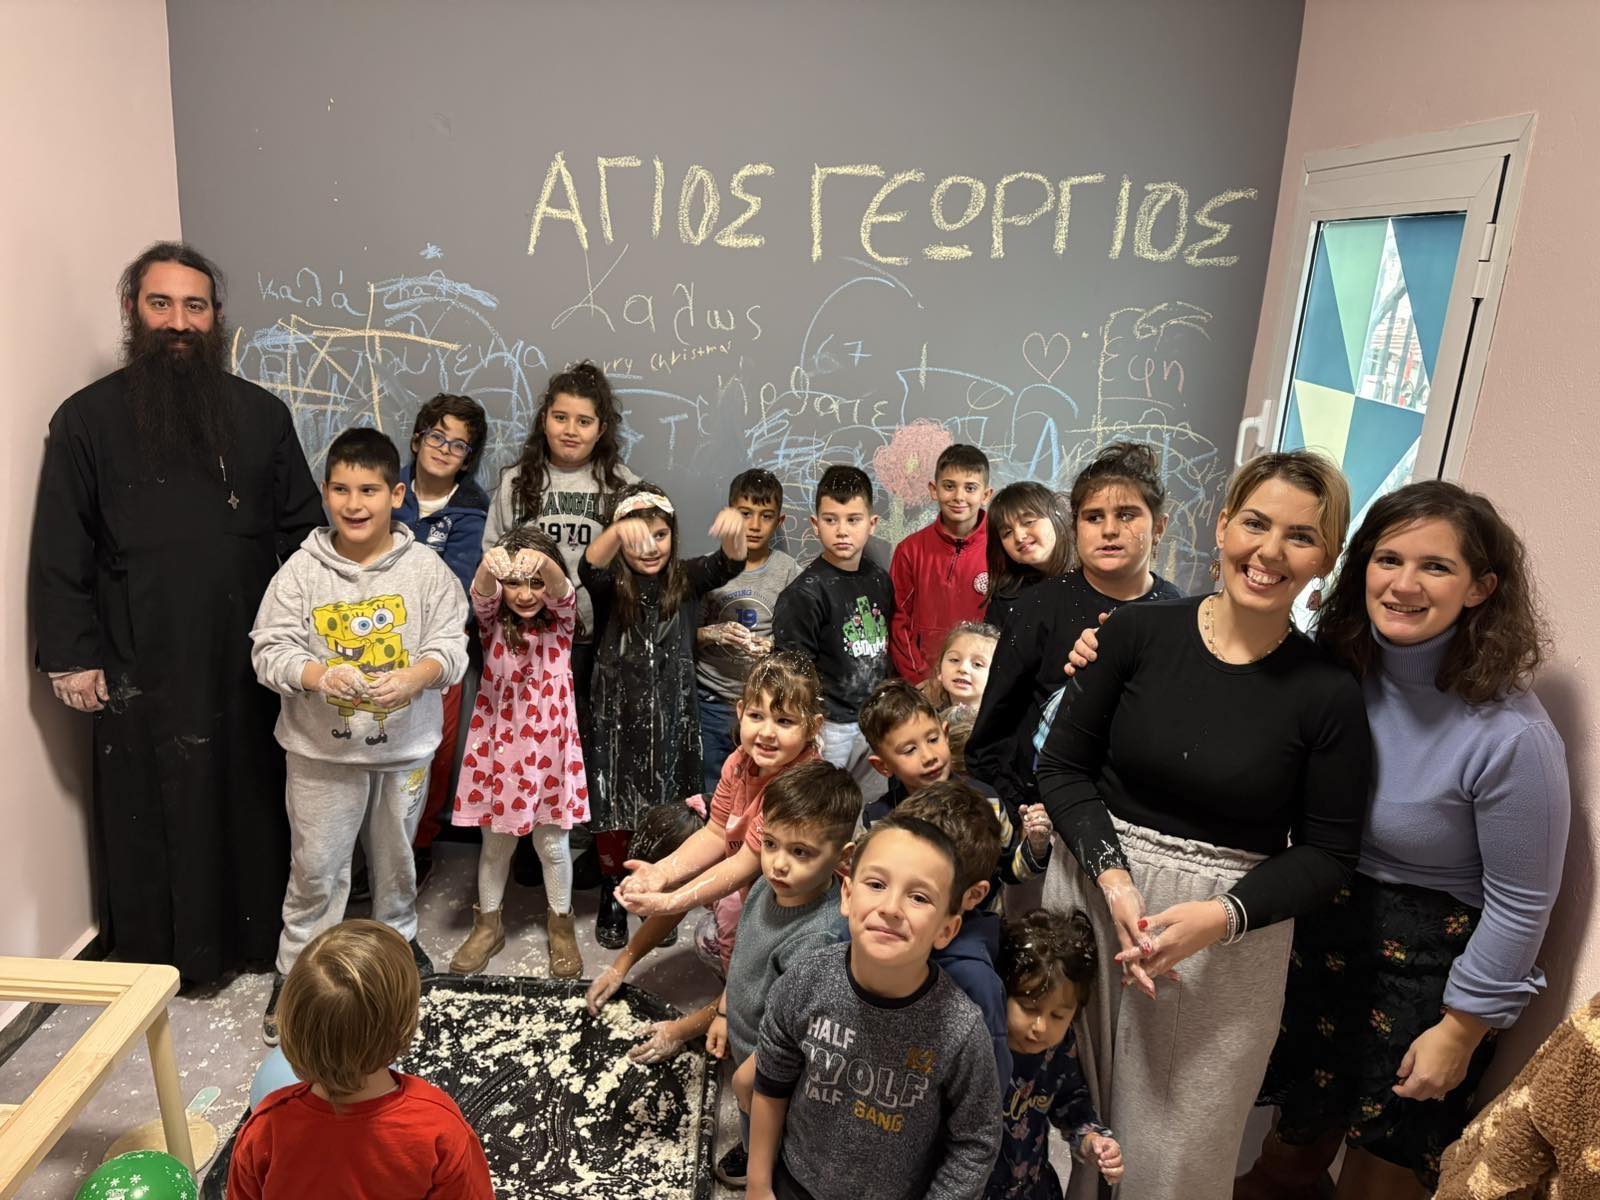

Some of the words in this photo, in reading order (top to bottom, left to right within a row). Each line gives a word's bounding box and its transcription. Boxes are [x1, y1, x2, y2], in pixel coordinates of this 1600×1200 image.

[527, 150, 776, 256] ΑΓΙΟΣ
[539, 521, 592, 545] 1970
[807, 1016, 856, 1049] HALF
[801, 1041, 930, 1109] WOLF
[853, 1100, 905, 1133] GANG
